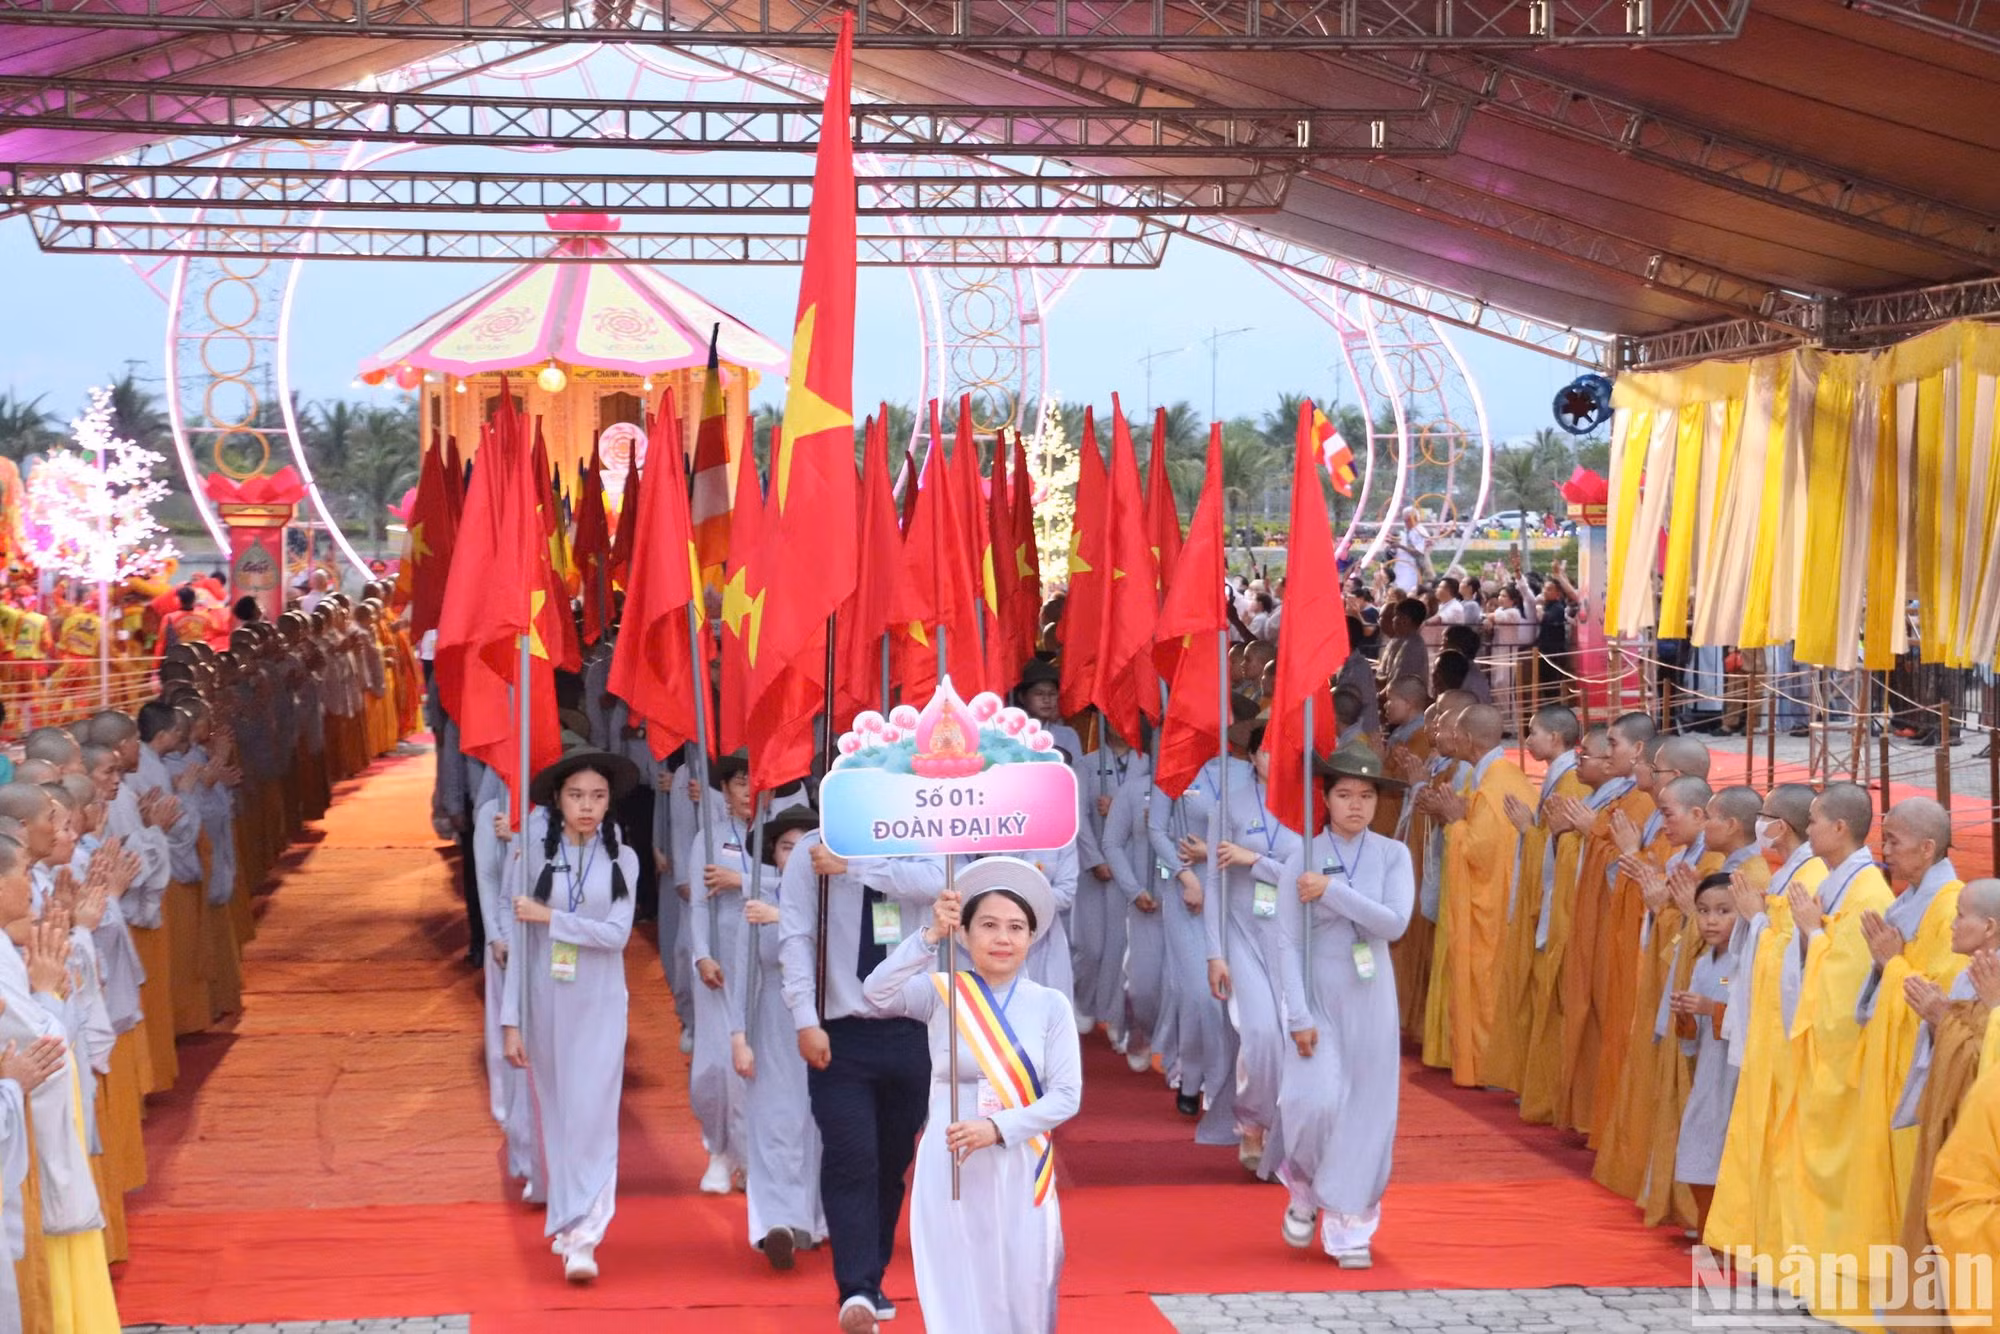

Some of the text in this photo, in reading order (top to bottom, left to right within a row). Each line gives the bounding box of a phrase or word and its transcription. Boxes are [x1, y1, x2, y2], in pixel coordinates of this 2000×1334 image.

[915, 785, 984, 808] Số 01:
[872, 811, 1027, 841] ĐOÀN ĐẠI KỲ
